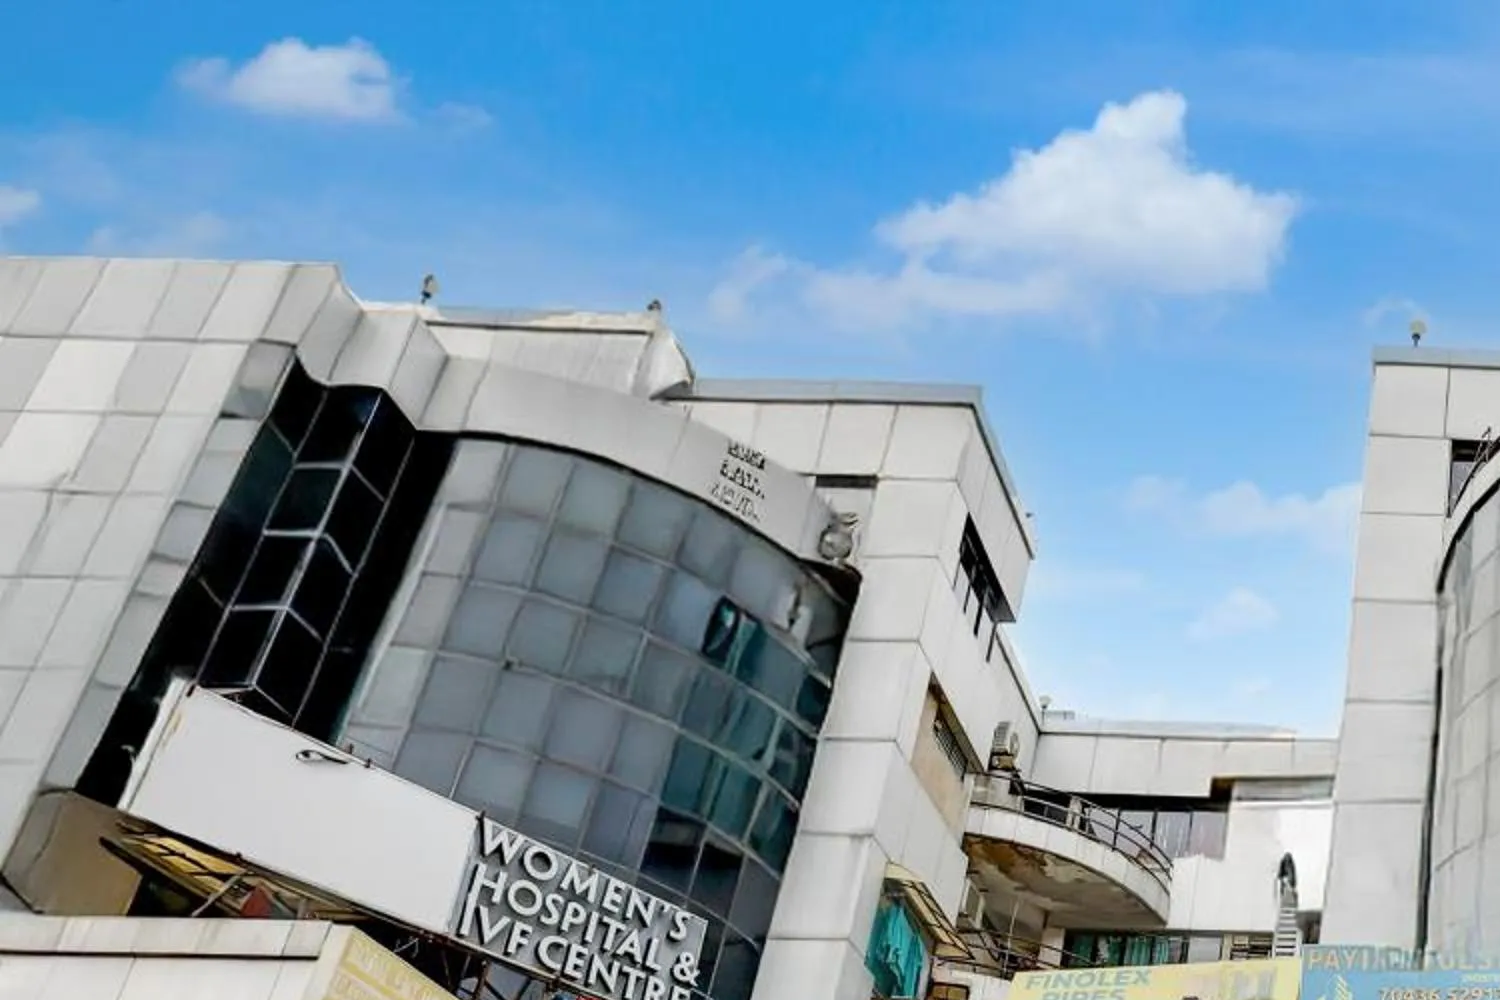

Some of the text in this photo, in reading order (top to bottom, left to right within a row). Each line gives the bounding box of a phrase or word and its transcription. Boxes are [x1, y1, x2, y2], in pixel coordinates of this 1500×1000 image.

[457, 894, 534, 956] IVF
[468, 863, 700, 988] HOSPITAL &
[480, 819, 690, 941] WOMEN'S
[1025, 969, 1150, 990] FINOLEX
